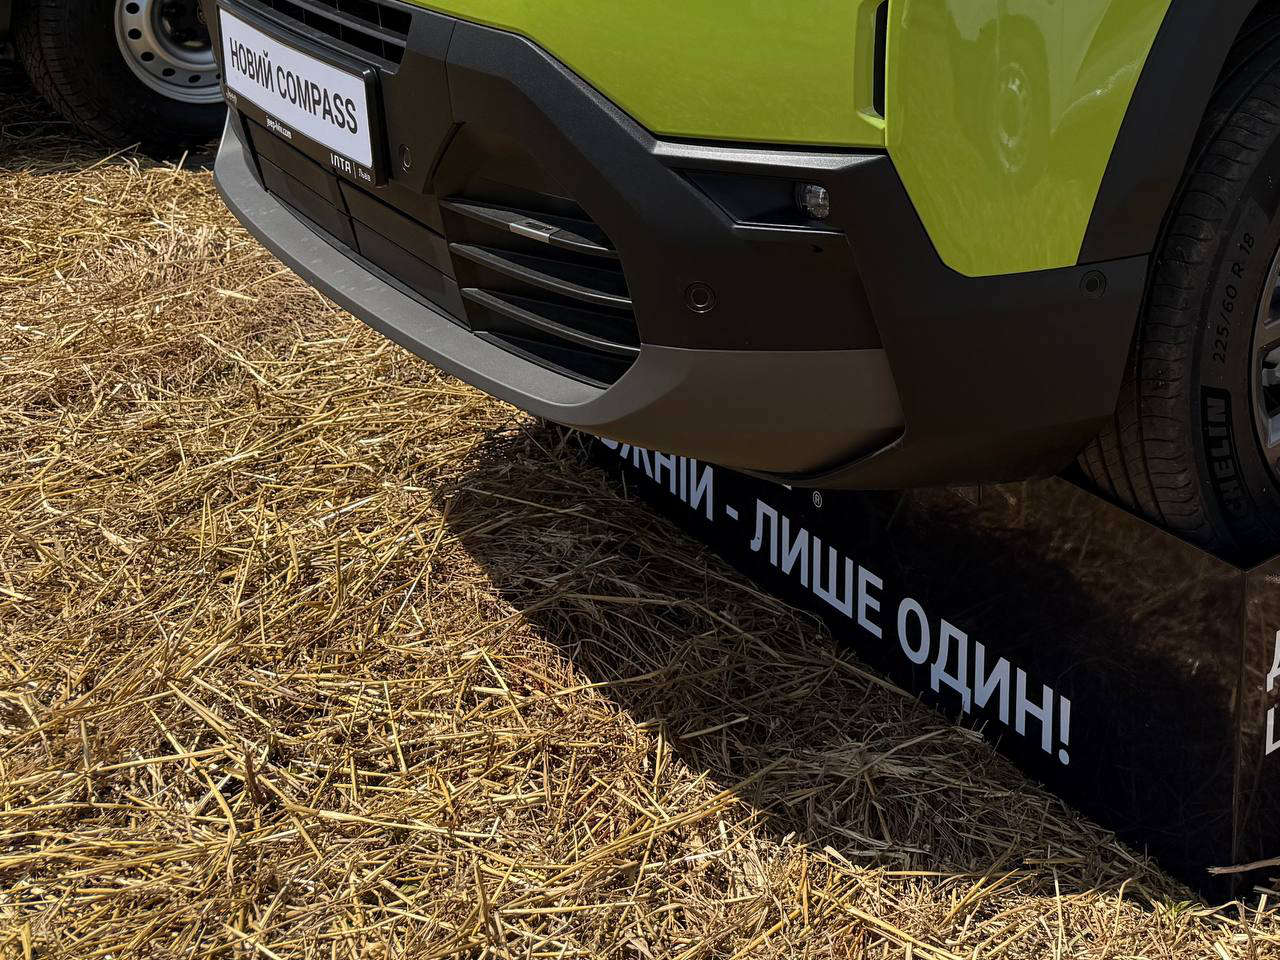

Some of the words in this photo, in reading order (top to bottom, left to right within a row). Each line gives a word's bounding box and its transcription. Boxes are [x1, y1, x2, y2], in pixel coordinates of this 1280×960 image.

[229, 37, 275, 93] НОВИЙ
[276, 65, 358, 135] COMPASS
[1212, 286, 1238, 364] 225/60
[1241, 230, 1256, 256] 18
[750, 498, 883, 639] ЛИШЕ
[897, 597, 1072, 766] ОДИН!
